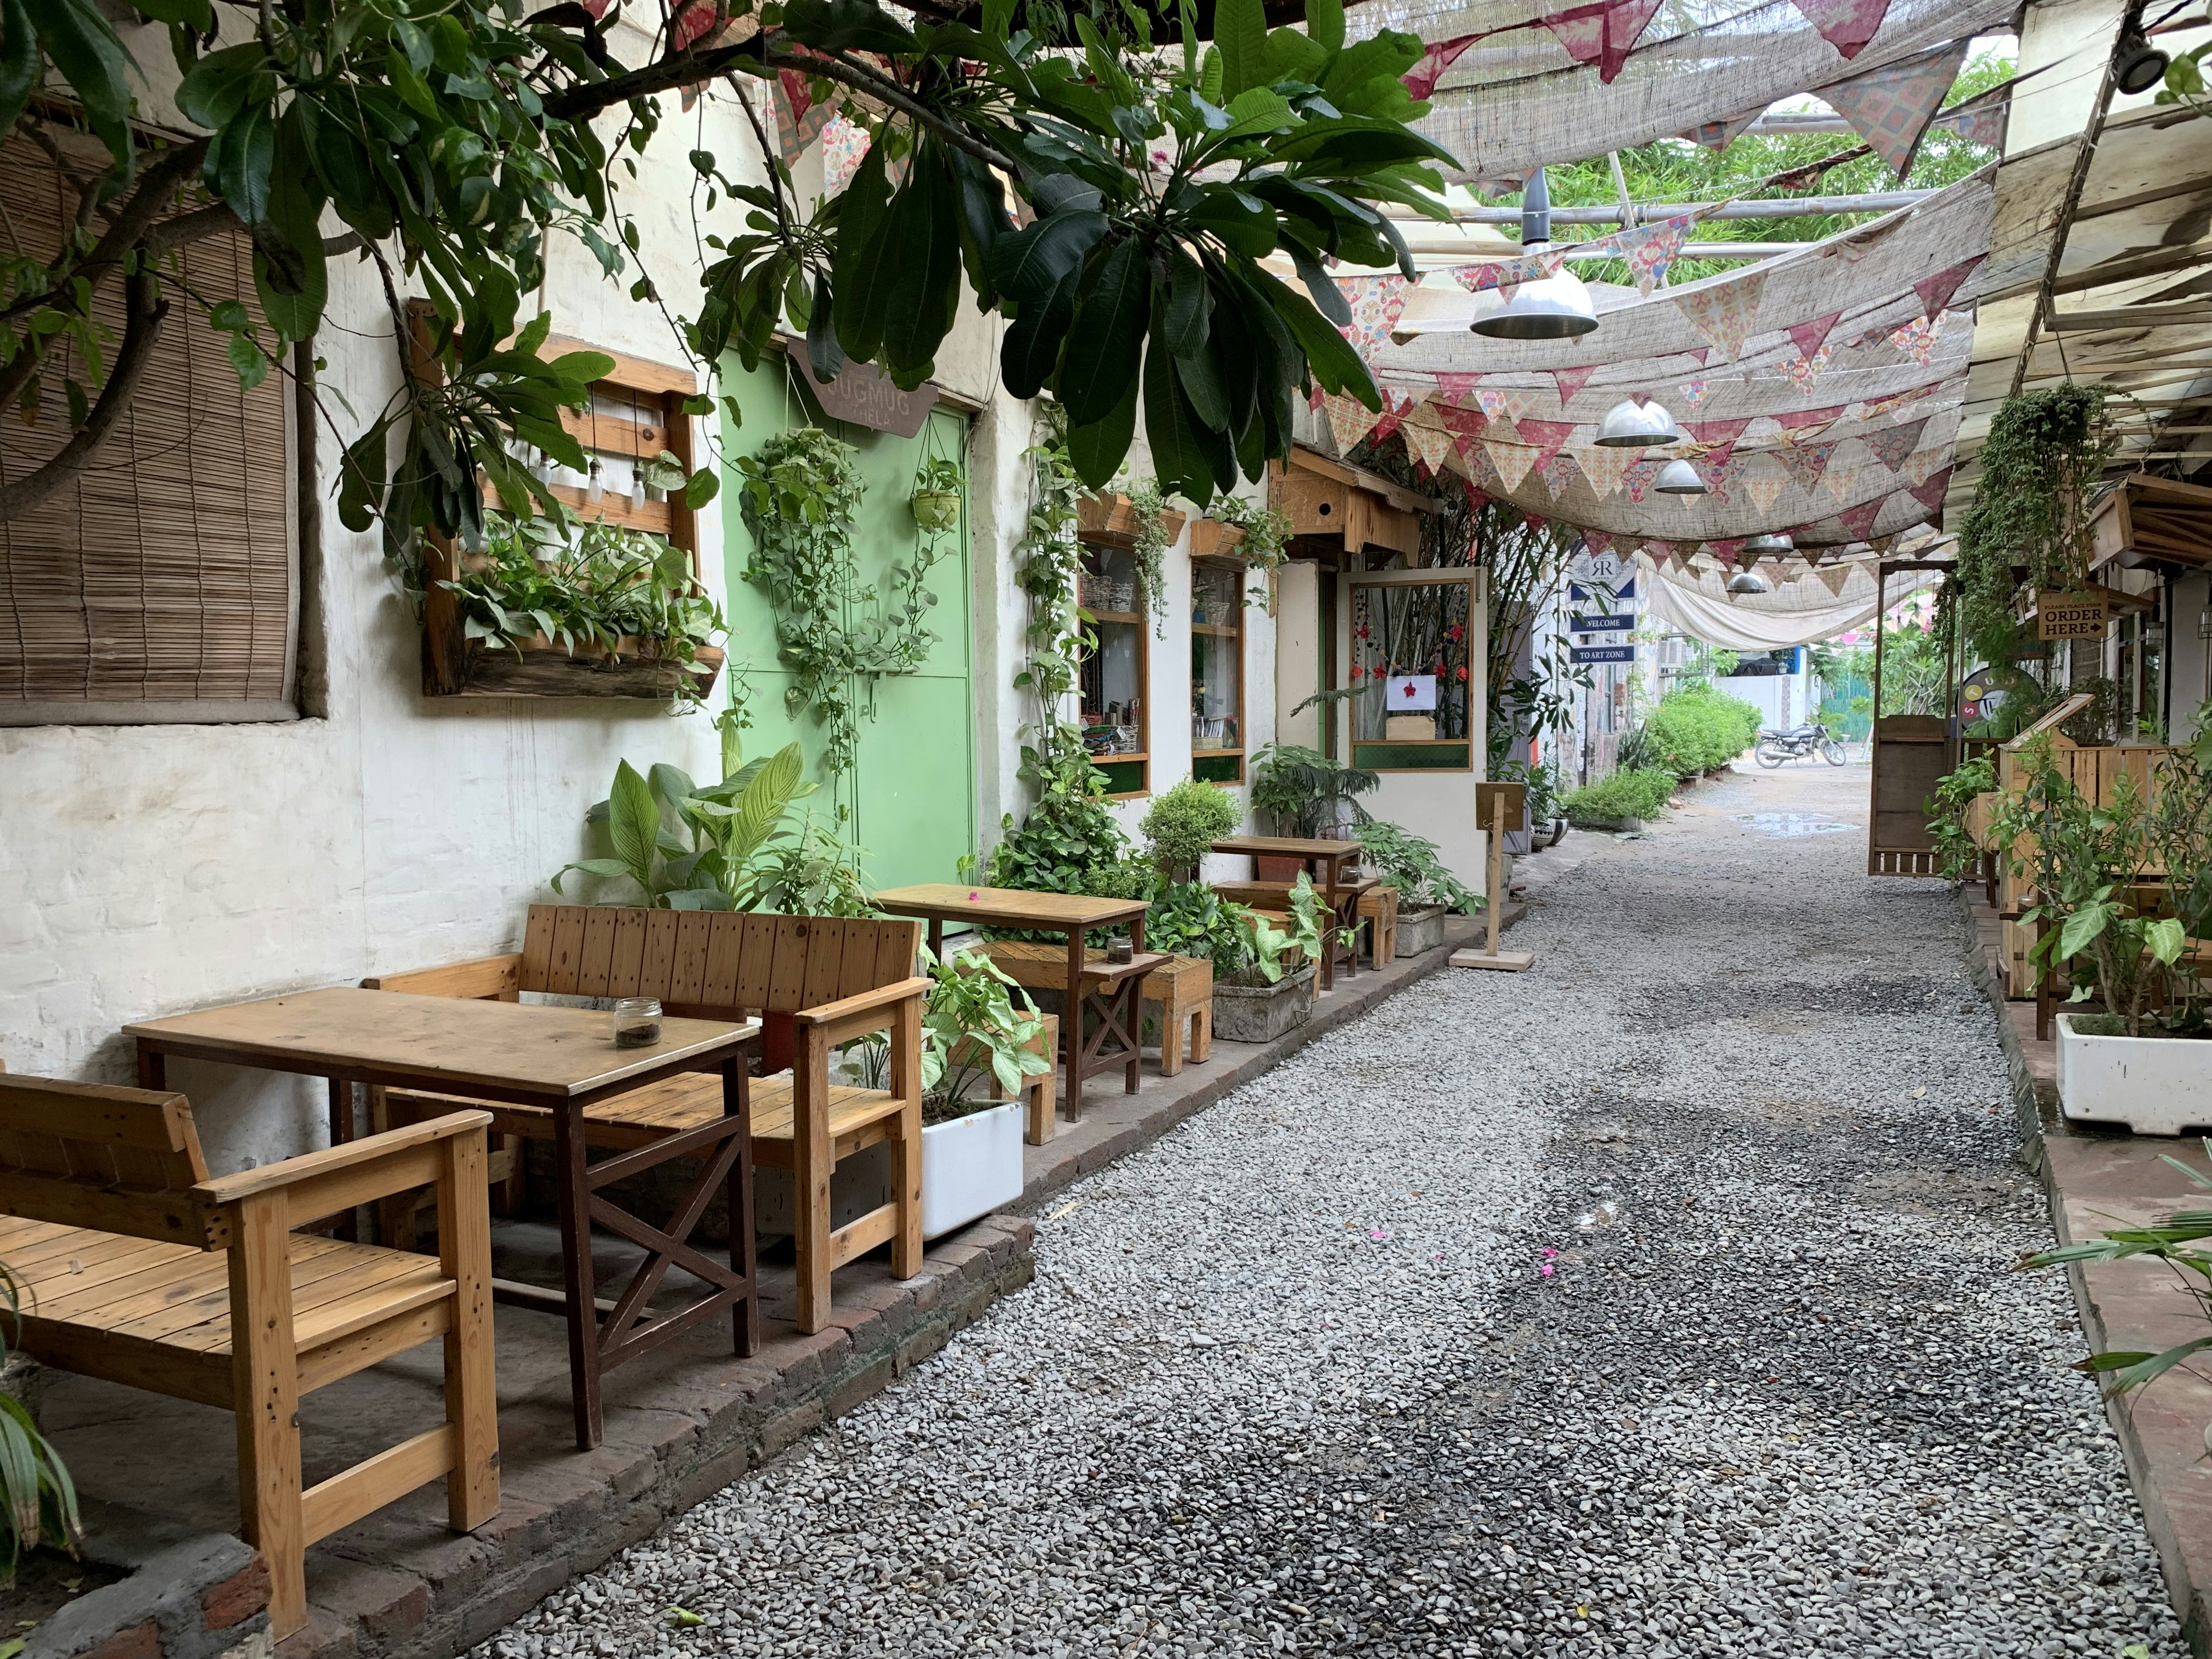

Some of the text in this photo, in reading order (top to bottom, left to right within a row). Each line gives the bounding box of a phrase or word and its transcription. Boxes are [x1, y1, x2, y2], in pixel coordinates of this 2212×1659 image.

[2045, 610, 2102, 622] ORDER
[2045, 623, 2089, 635] HERE
[1606, 650, 1625, 658] ZONE
